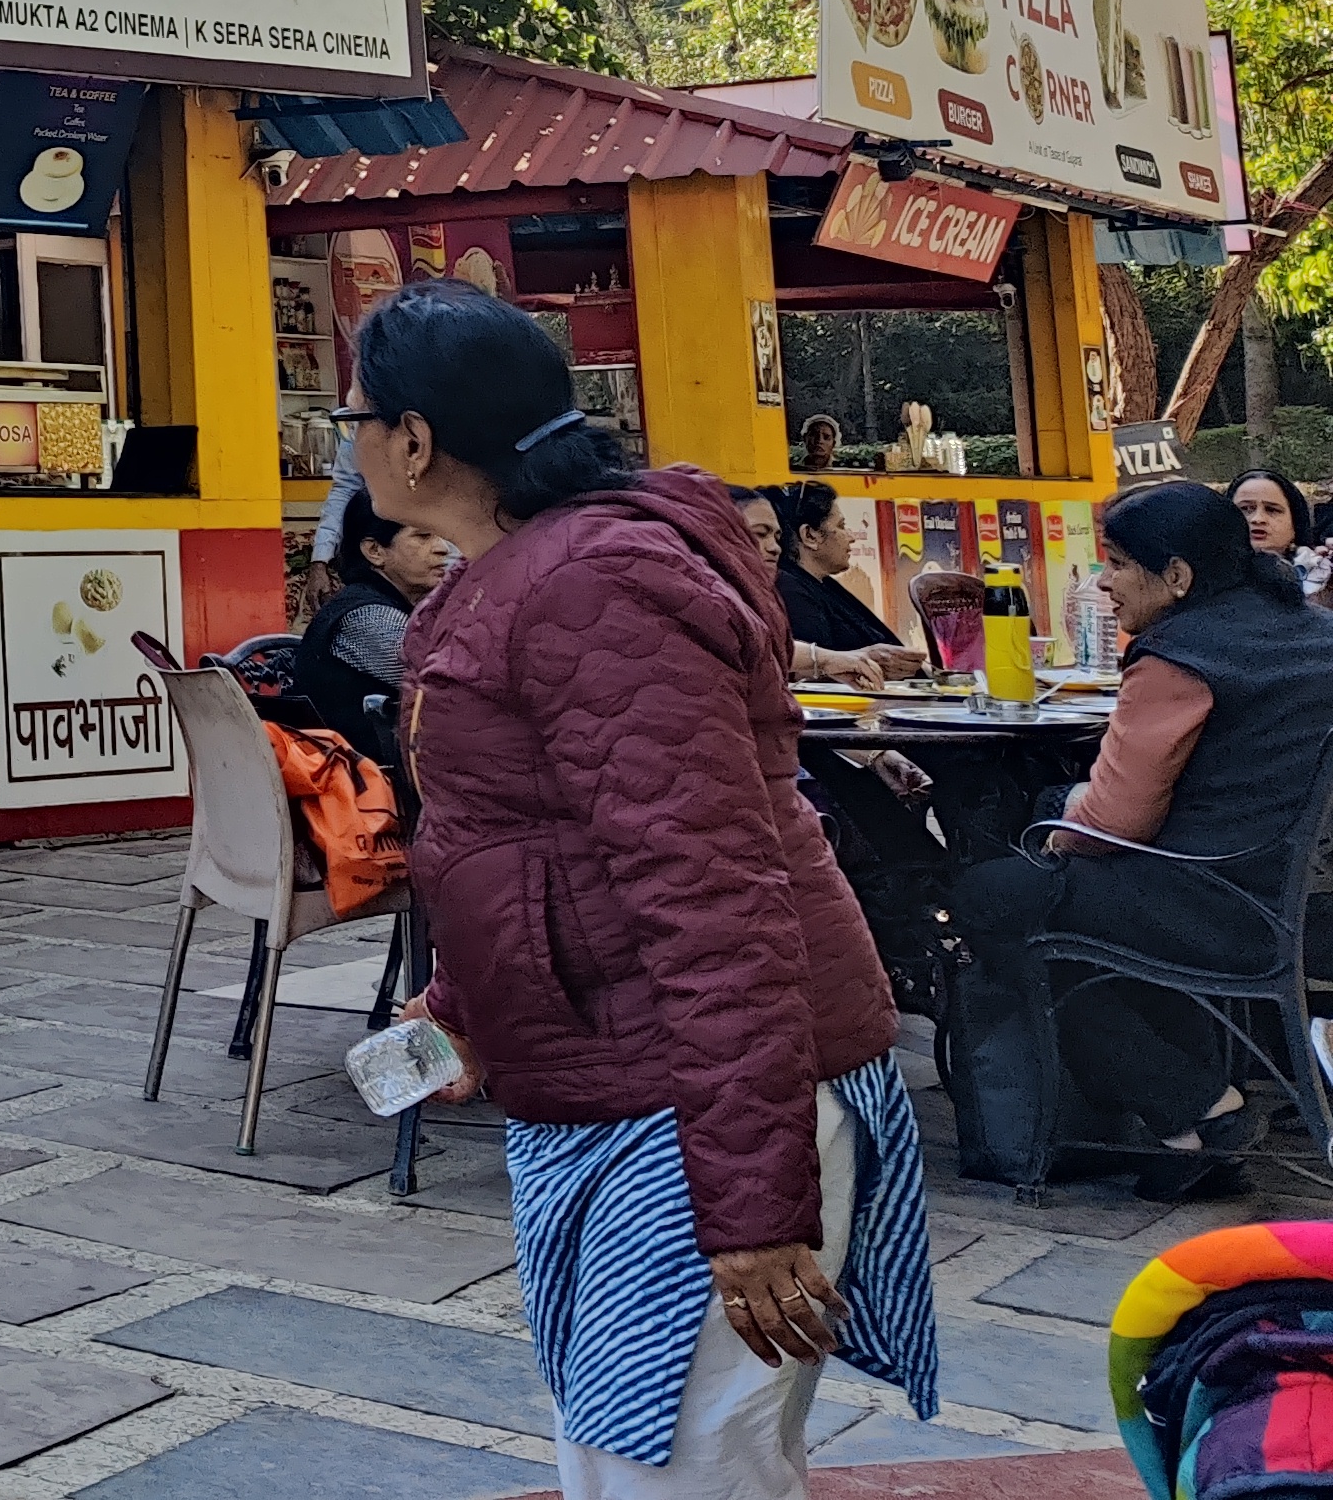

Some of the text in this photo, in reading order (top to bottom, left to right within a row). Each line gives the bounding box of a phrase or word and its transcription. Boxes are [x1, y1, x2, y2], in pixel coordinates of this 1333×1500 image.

[75, 9, 99, 32] A2
[104, 11, 179, 40] CINEMA
[195, 20, 208, 43] K
[213, 22, 263, 48] SERA
[268, 28, 318, 53] SERA
[323, 32, 391, 60] CINEMA
[49, 86, 69, 98] TEA
[79, 90, 118, 102] COFFEE
[868, 77, 895, 105] PIZZA
[948, 102, 984, 133] BURGER
[1119, 154, 1158, 180] SANDWICH
[891, 194, 1006, 264] ICE CREAM
[13, 673, 162, 761] पावभाजी
